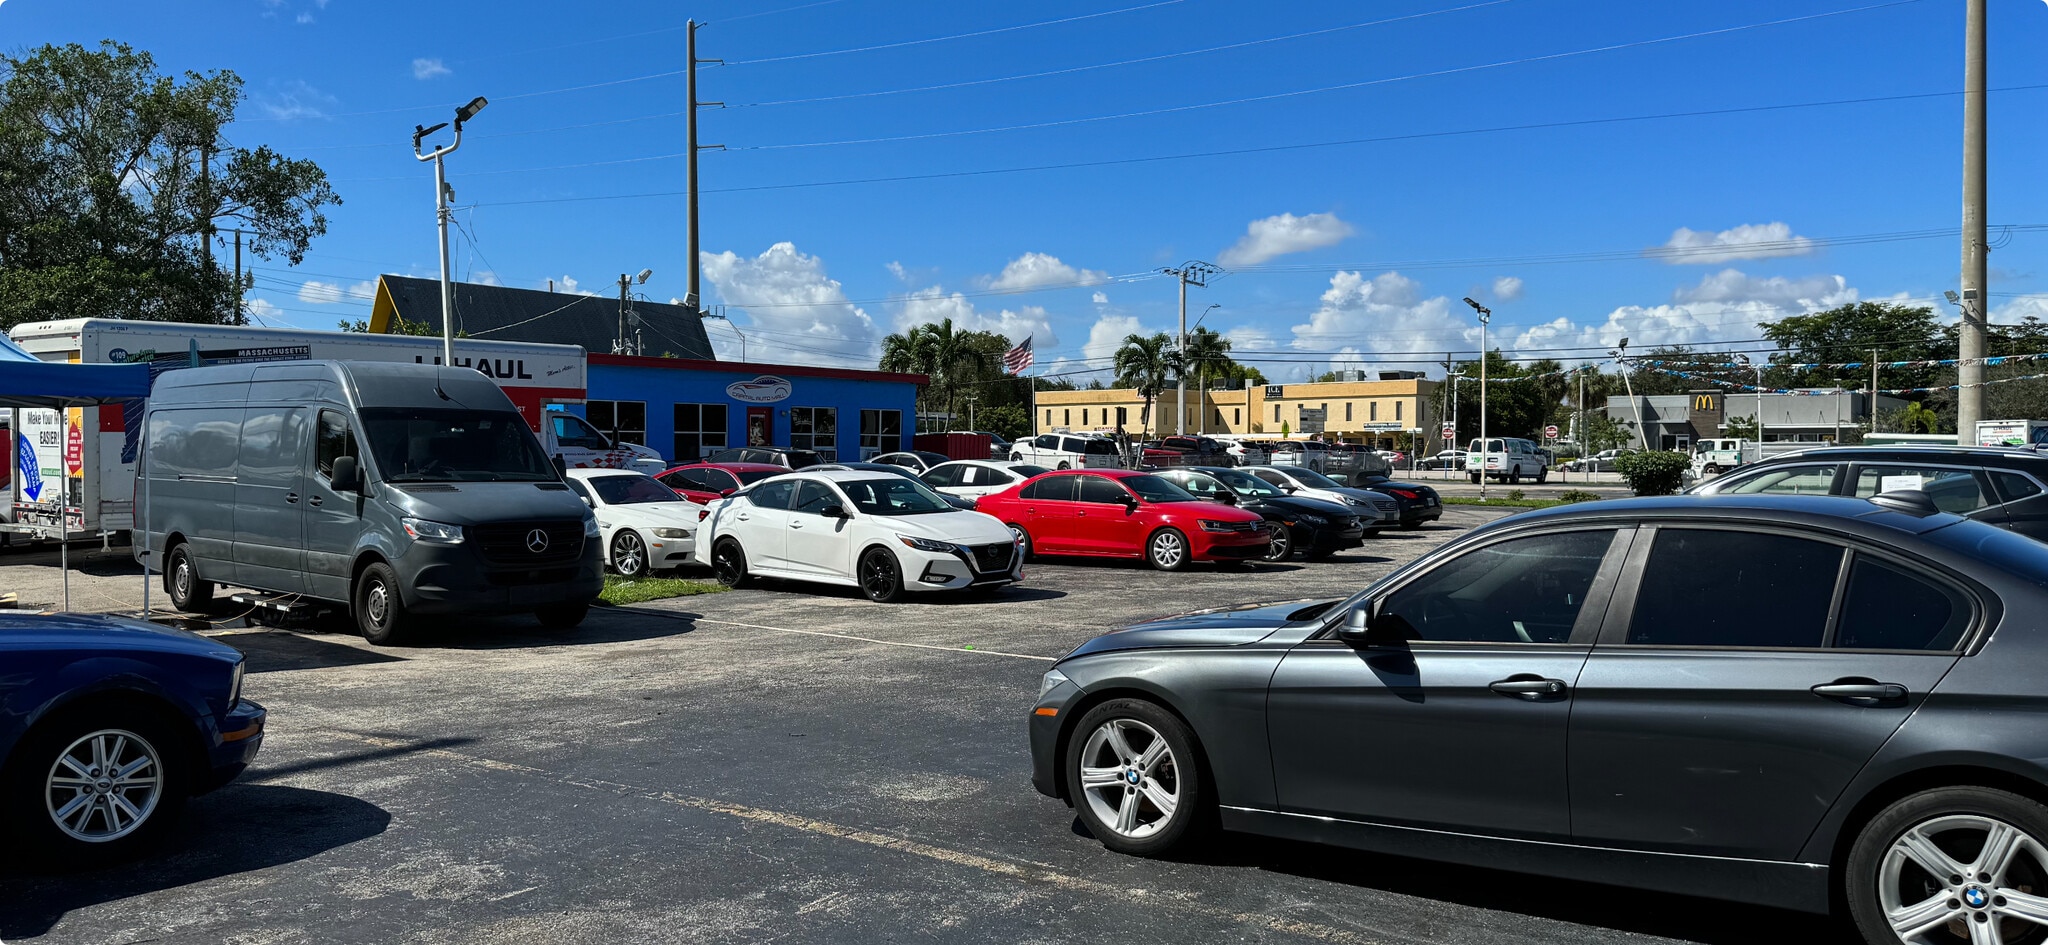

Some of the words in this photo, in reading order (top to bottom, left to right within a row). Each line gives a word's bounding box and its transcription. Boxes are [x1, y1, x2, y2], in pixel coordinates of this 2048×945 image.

[238, 347, 308, 357] MASSACHUSETTS
[27, 411, 41, 425] Make
[42, 411, 53, 425] Your
[54, 412, 68, 425] Me
[40, 431, 60, 445] EASIER!
